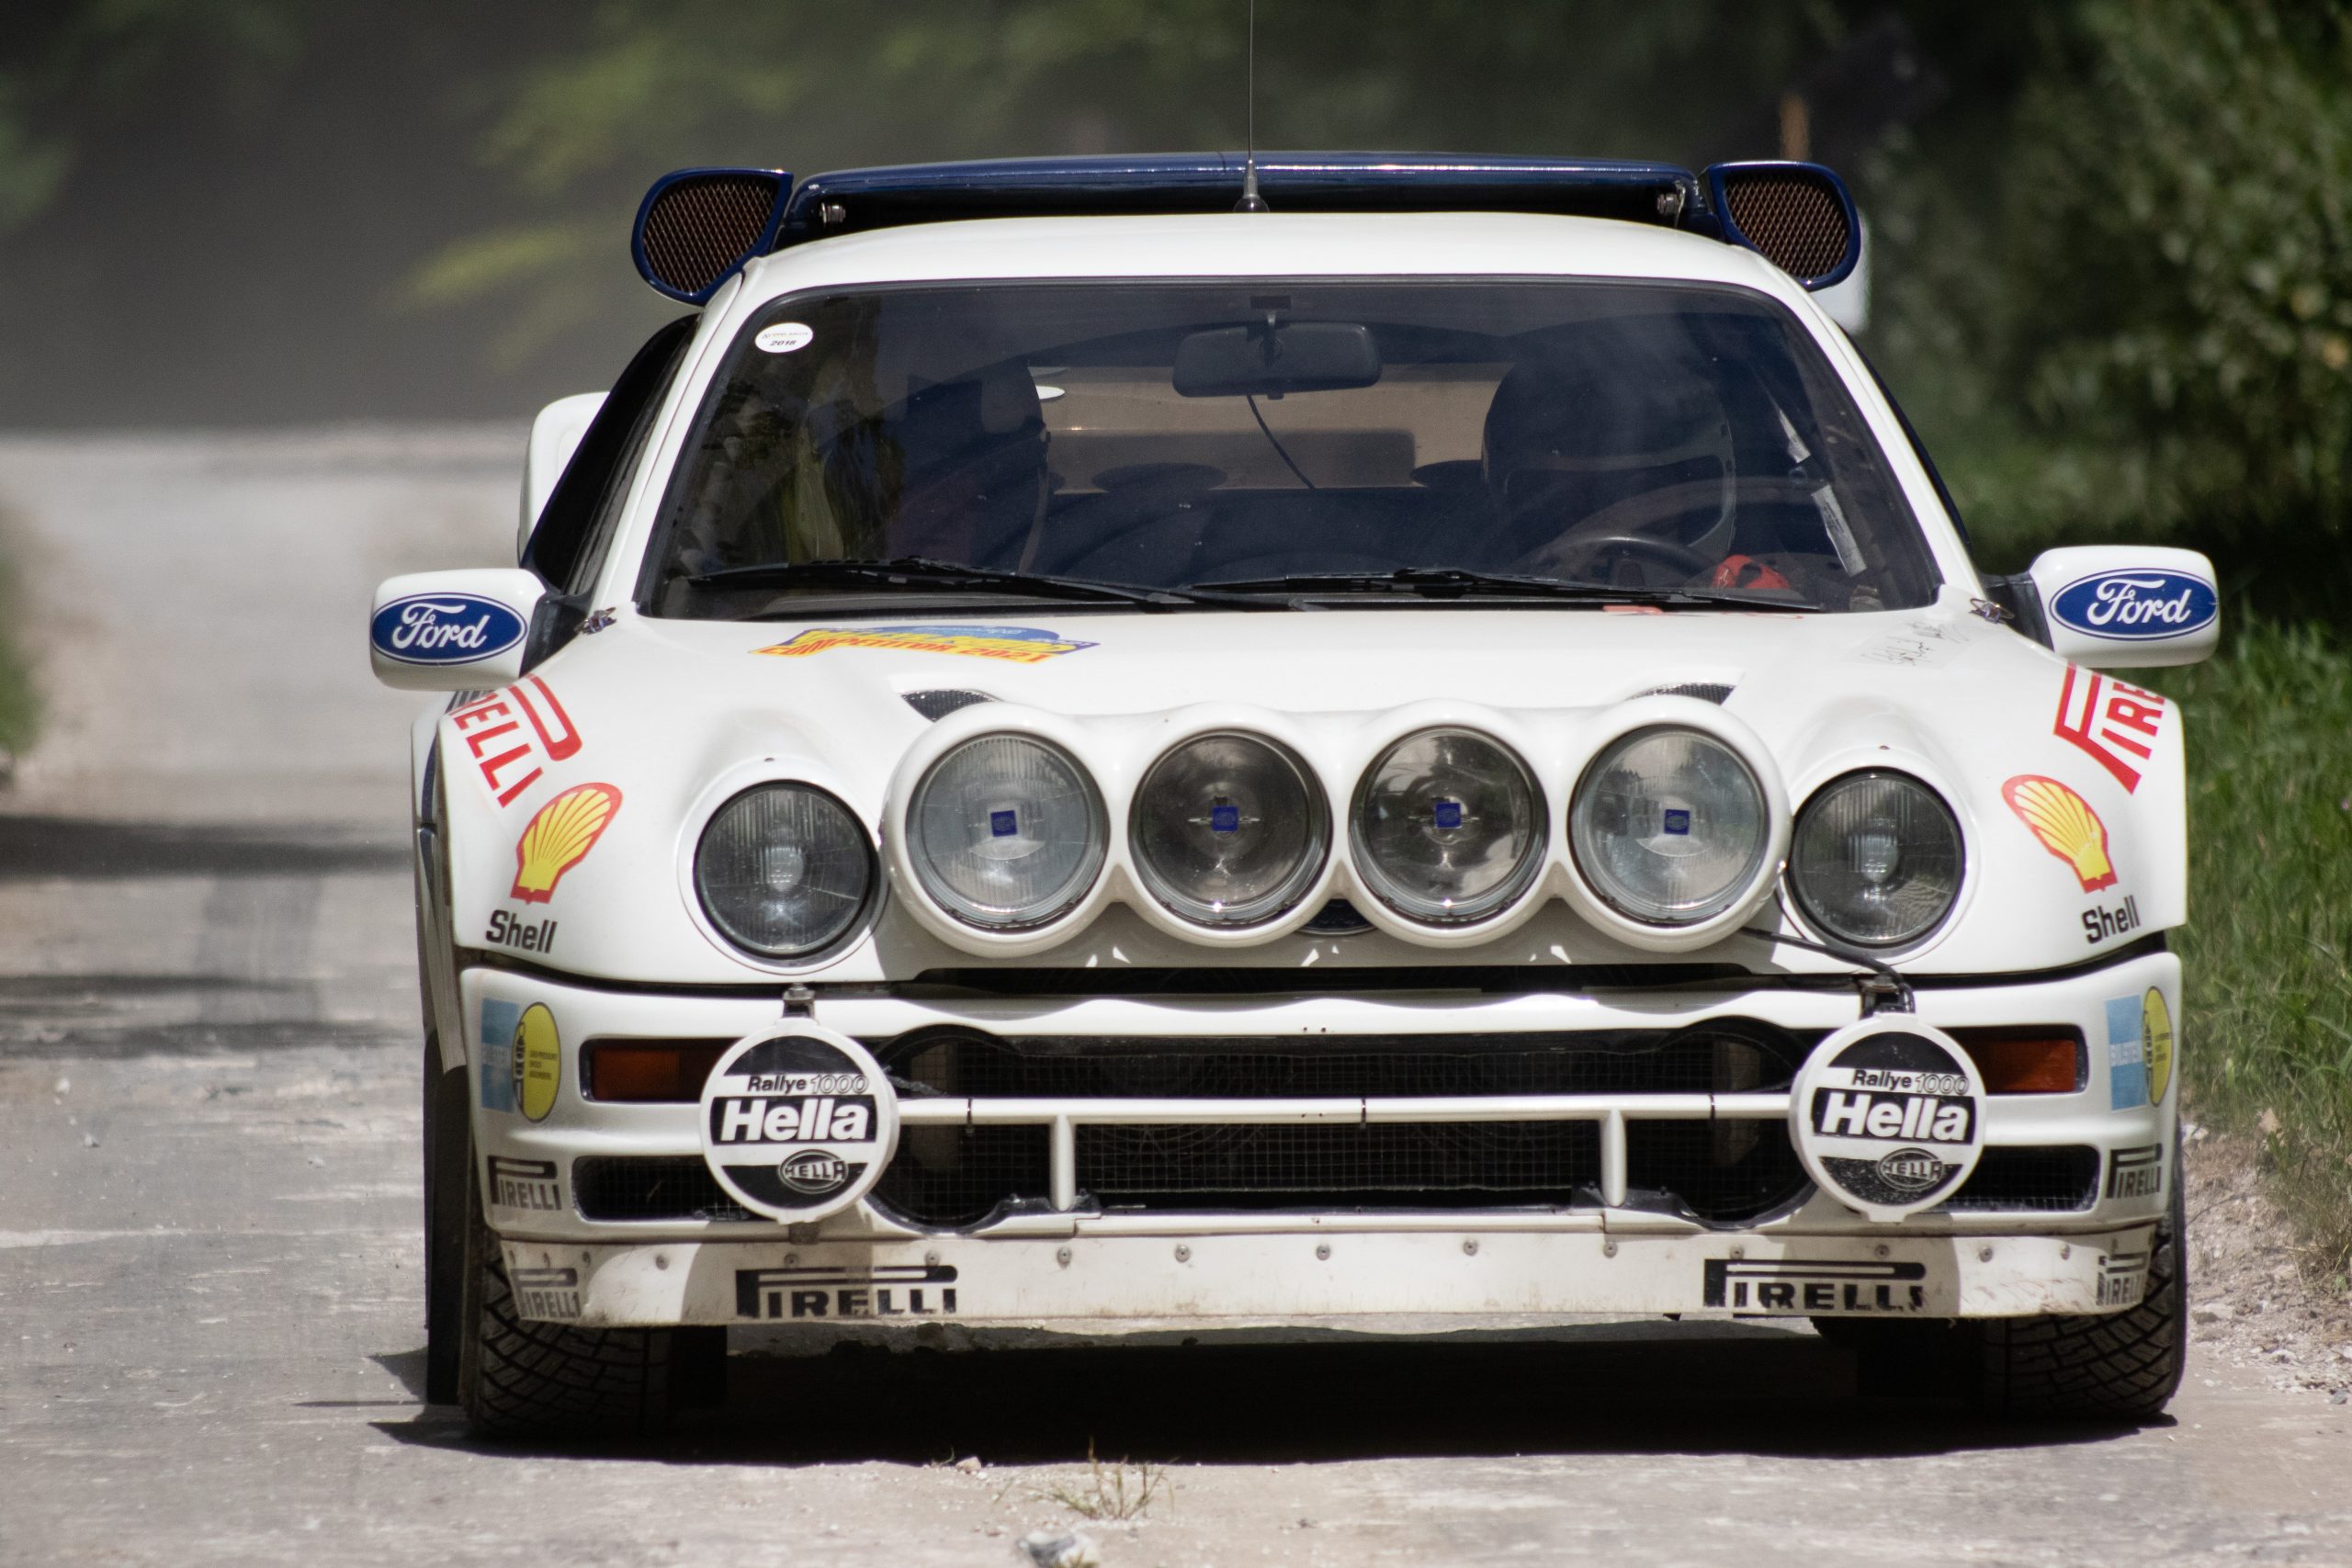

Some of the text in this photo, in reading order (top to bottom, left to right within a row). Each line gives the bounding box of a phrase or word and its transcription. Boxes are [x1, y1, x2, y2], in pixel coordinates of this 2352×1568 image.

[2086, 579, 2192, 625] Ford
[392, 603, 490, 649] Ford
[486, 909, 557, 953] Shell
[2082, 895, 2140, 943] Shell
[748, 1074, 869, 1094] Rallye 1000
[1852, 1069, 1969, 1095] Rallye 1000
[720, 1098, 869, 1141] Hella
[1821, 1092, 1968, 1141] Hella
[487, 1156, 562, 1210] PIRELLI
[785, 1160, 845, 1181] HELLA
[1883, 1160, 1943, 1182] HELLA
[2107, 1143, 2162, 1198] PIRELLI
[735, 1265, 957, 1318] PIRELLI
[1703, 1258, 1926, 1311] PIRELLI
